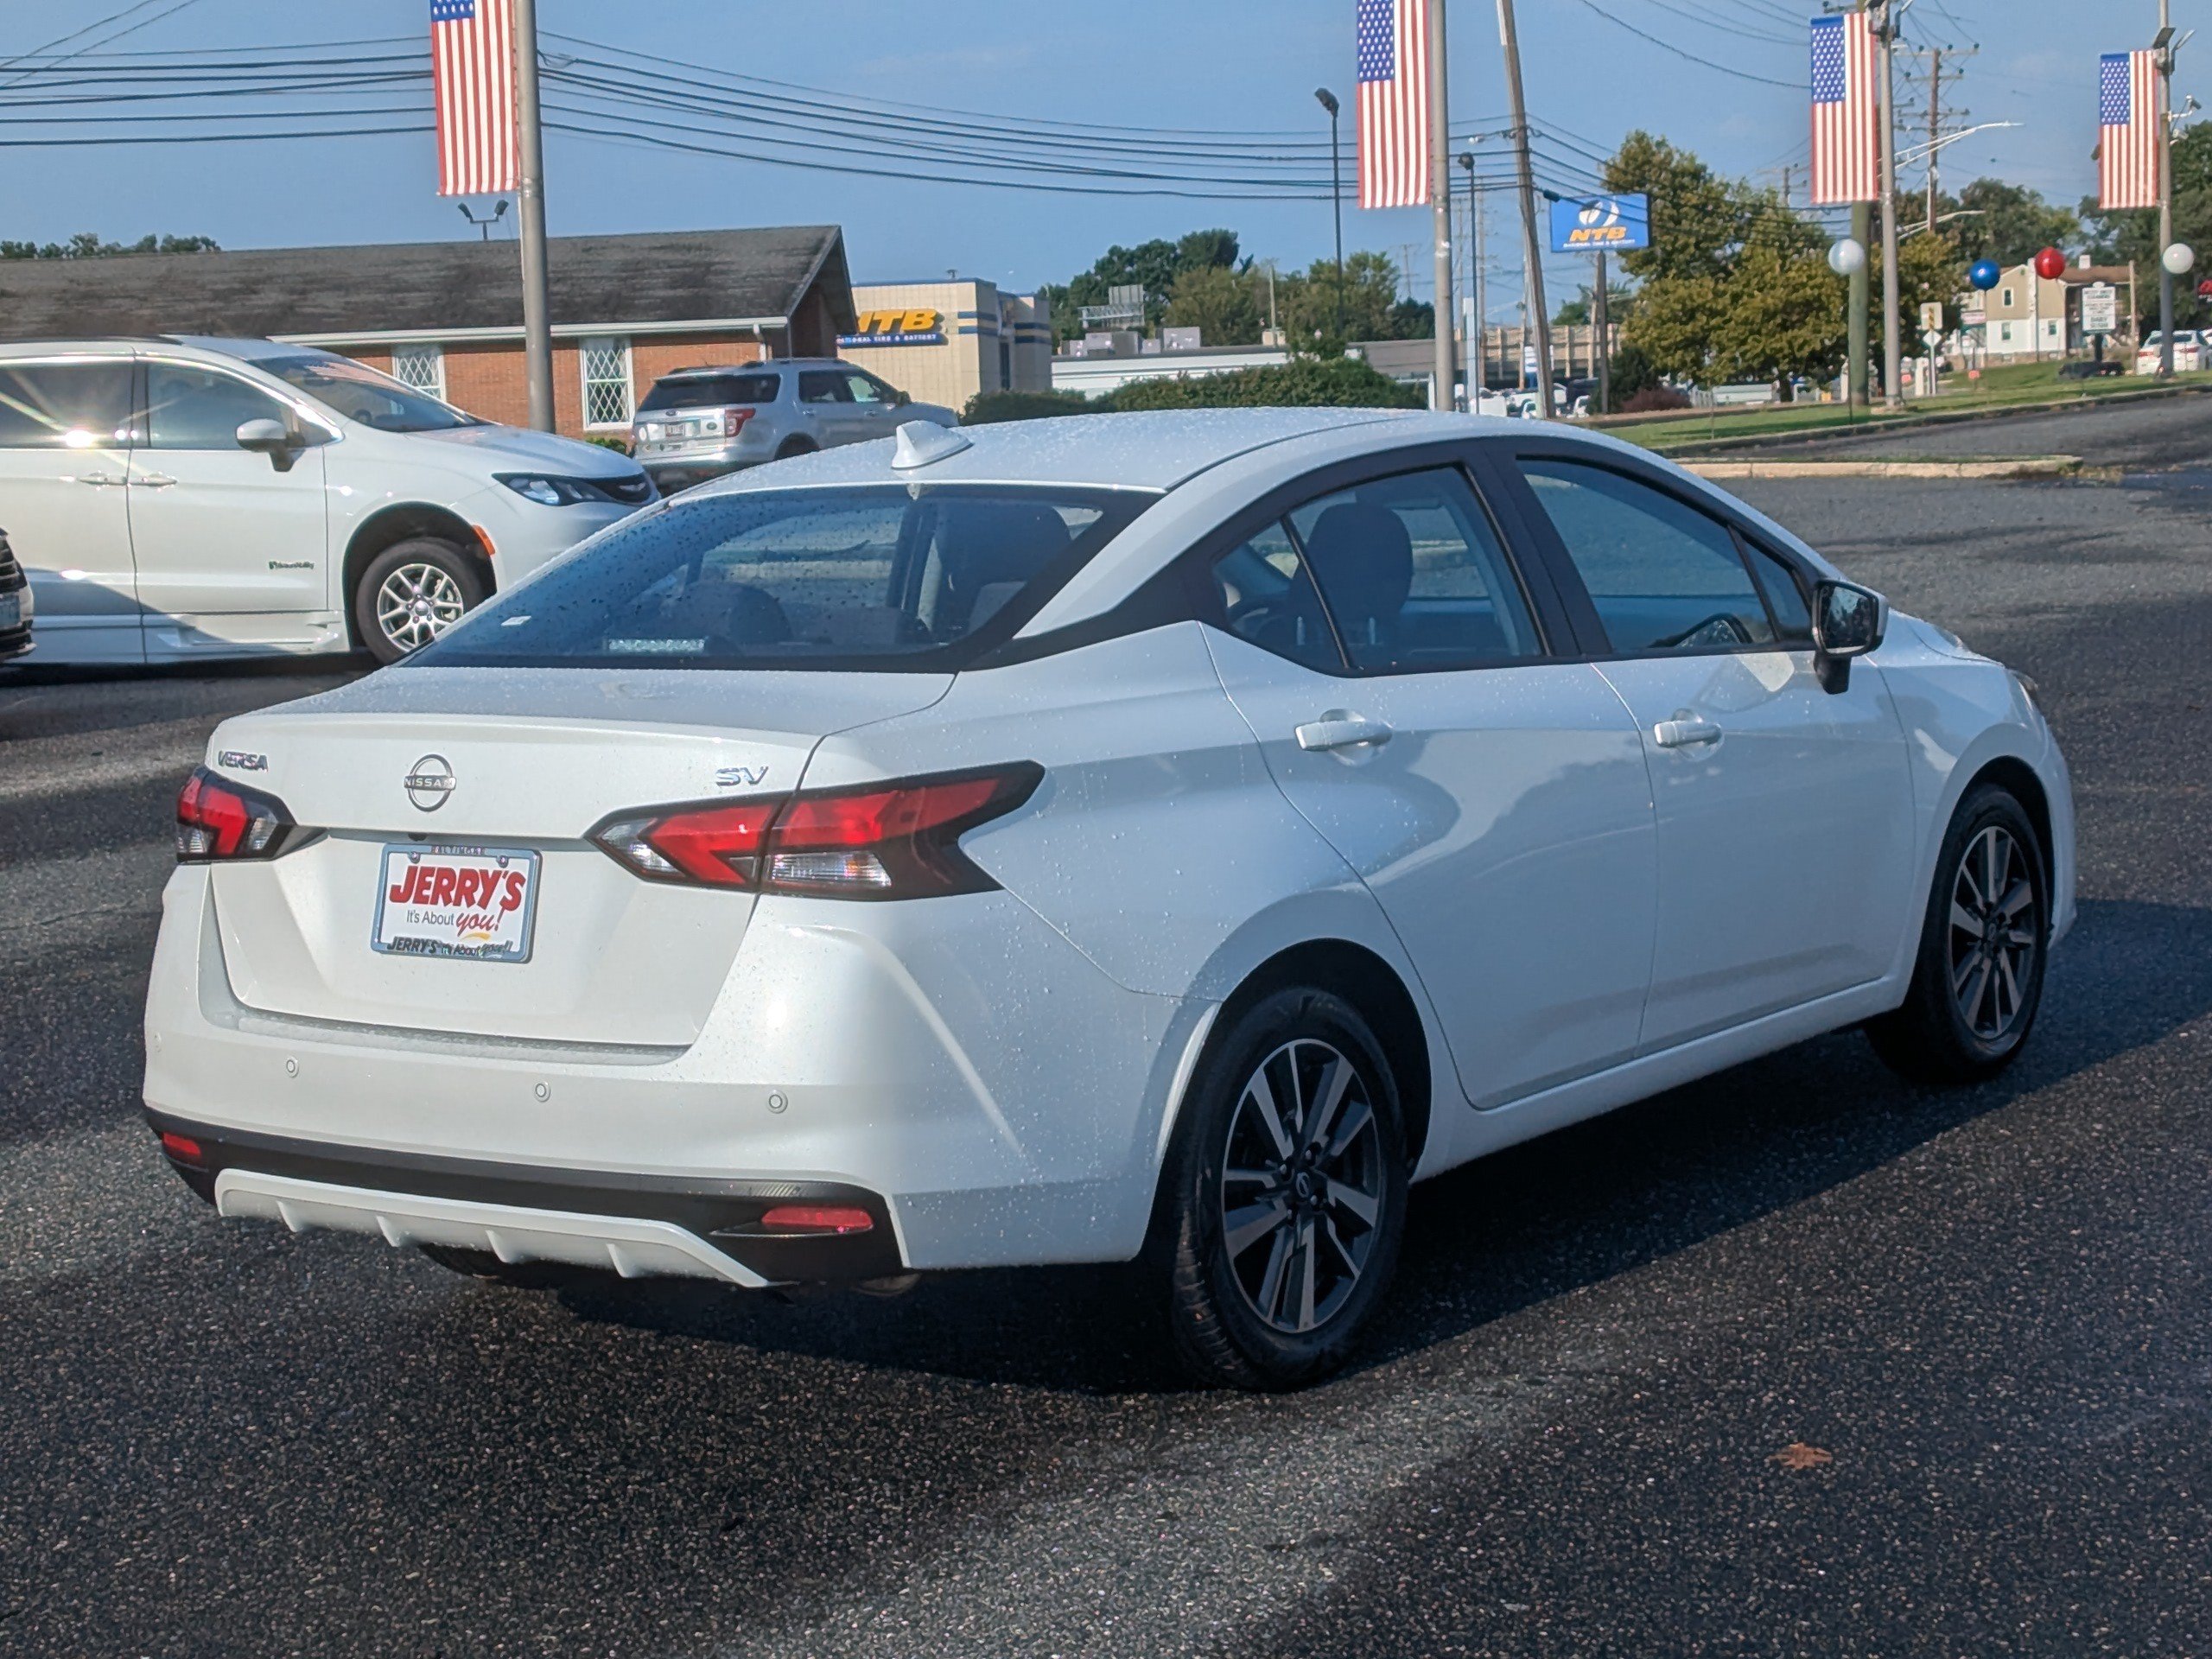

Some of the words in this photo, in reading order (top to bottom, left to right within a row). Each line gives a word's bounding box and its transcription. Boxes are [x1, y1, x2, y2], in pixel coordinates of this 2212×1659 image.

[1569, 226, 1627, 242] NTB
[219, 750, 269, 772] VERSA
[404, 777, 454, 788] NISSAN
[715, 766, 769, 786] SV
[390, 865, 526, 912] JERRY'S
[406, 909, 420, 924] It's
[422, 911, 454, 925] About
[455, 907, 505, 938] you!
[387, 936, 439, 955] JERRY'S
